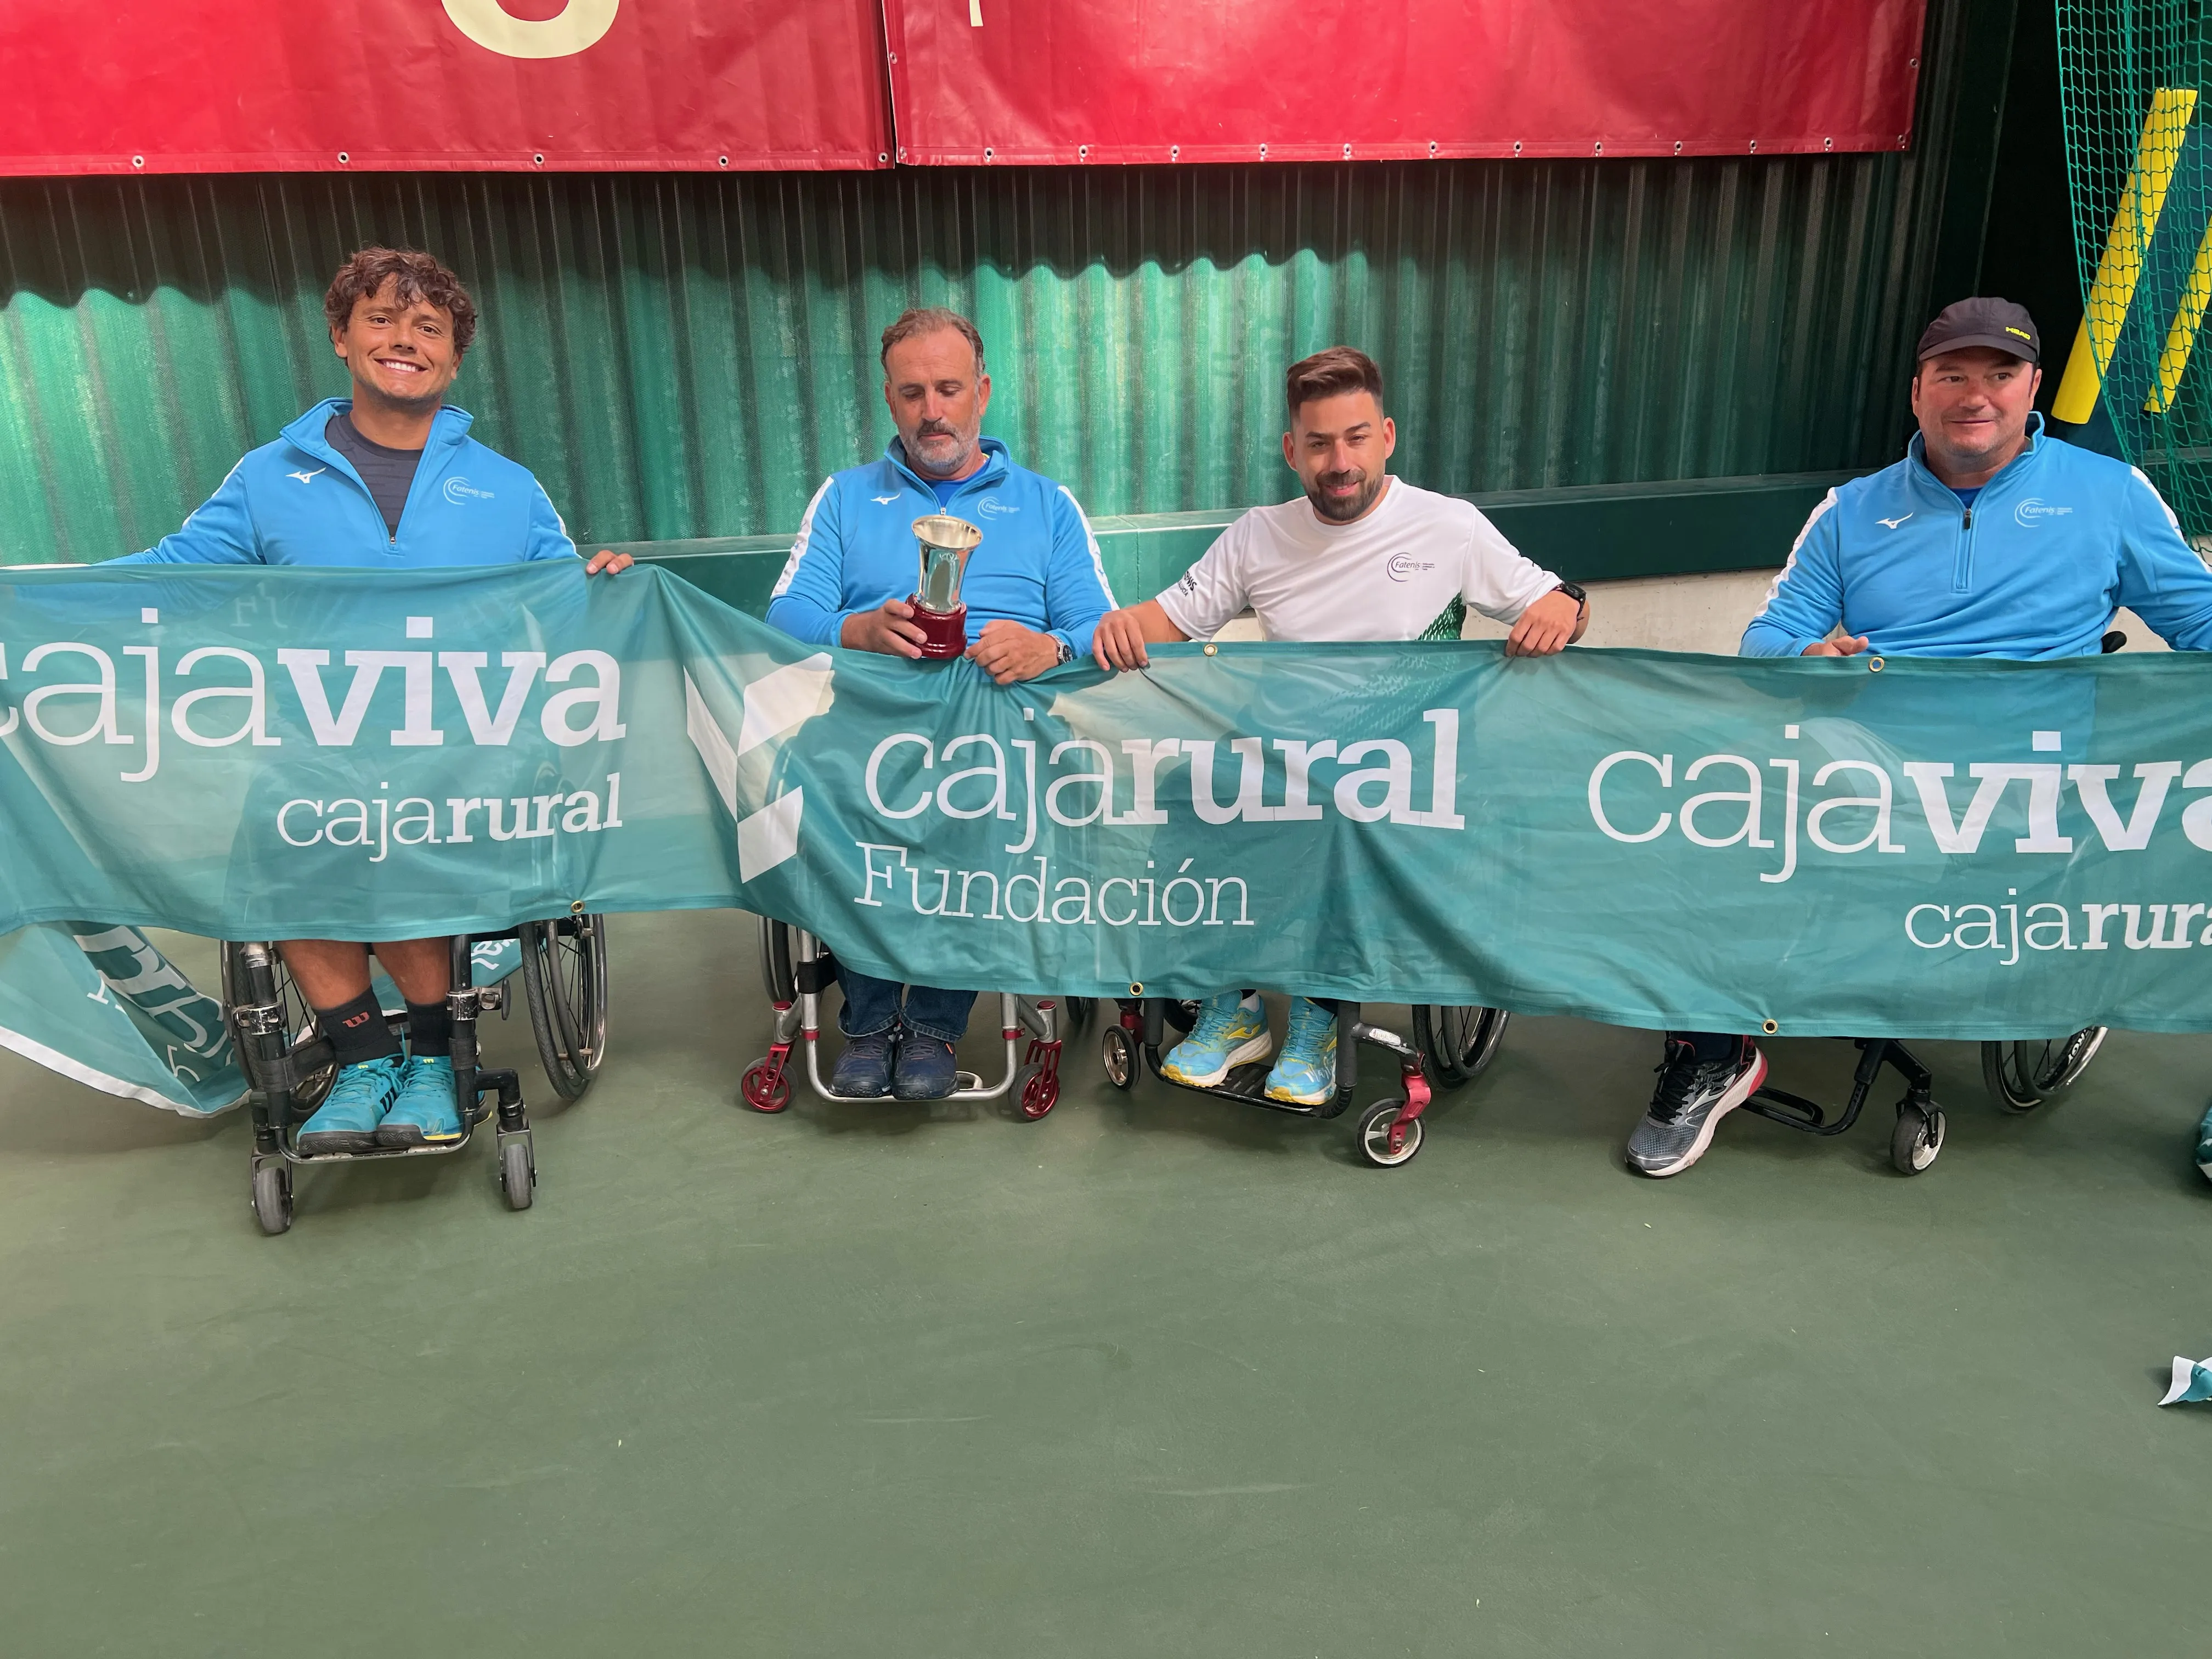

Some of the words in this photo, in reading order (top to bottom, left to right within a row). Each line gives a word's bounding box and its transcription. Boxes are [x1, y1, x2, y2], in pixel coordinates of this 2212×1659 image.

[0, 607, 627, 782] ajaviva
[277, 772, 623, 862] cajarural
[865, 707, 1465, 853] cajarural
[854, 842, 1255, 926] Fundación
[1904, 888, 2212, 966] cajarur
